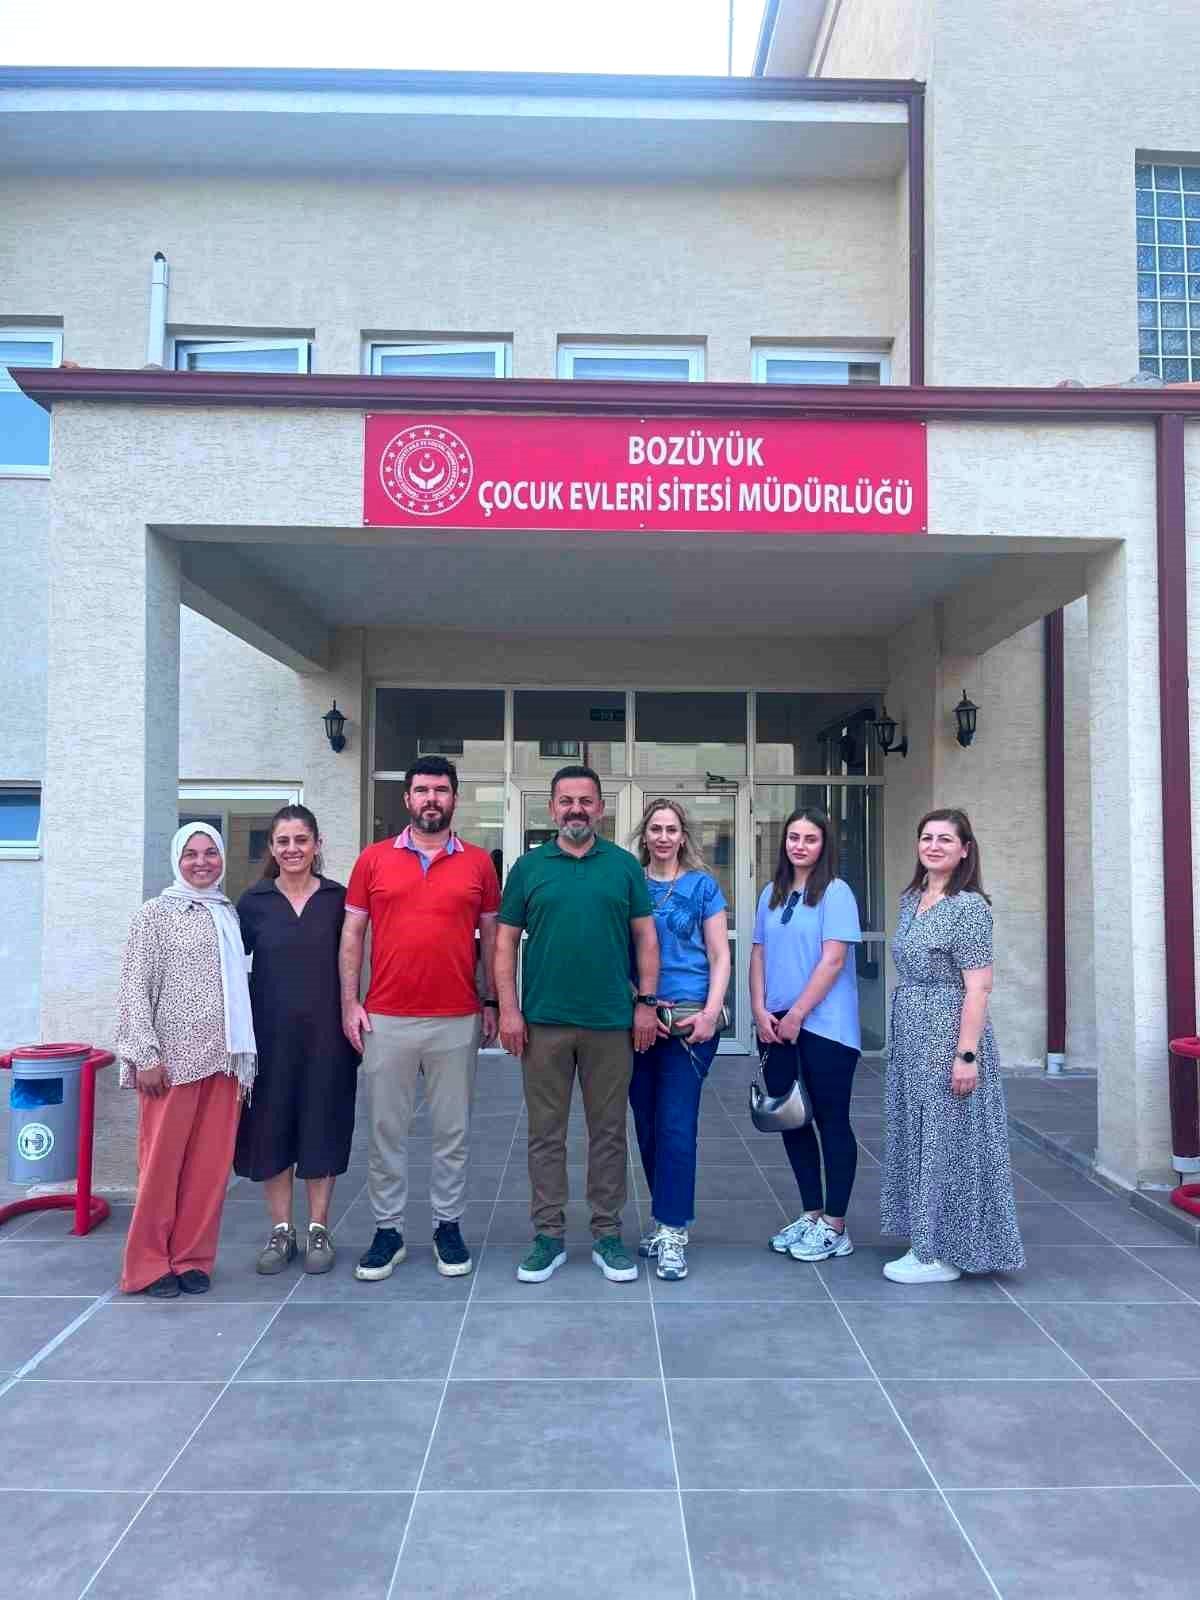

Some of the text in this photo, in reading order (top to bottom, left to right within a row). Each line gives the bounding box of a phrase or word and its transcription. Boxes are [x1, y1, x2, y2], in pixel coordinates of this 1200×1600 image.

[628, 430, 764, 467] BOZÜYÜK
[478, 476, 913, 517] ÇOCUK EVLERİ SİTESİ MÜDÜRLÜĞÜ
